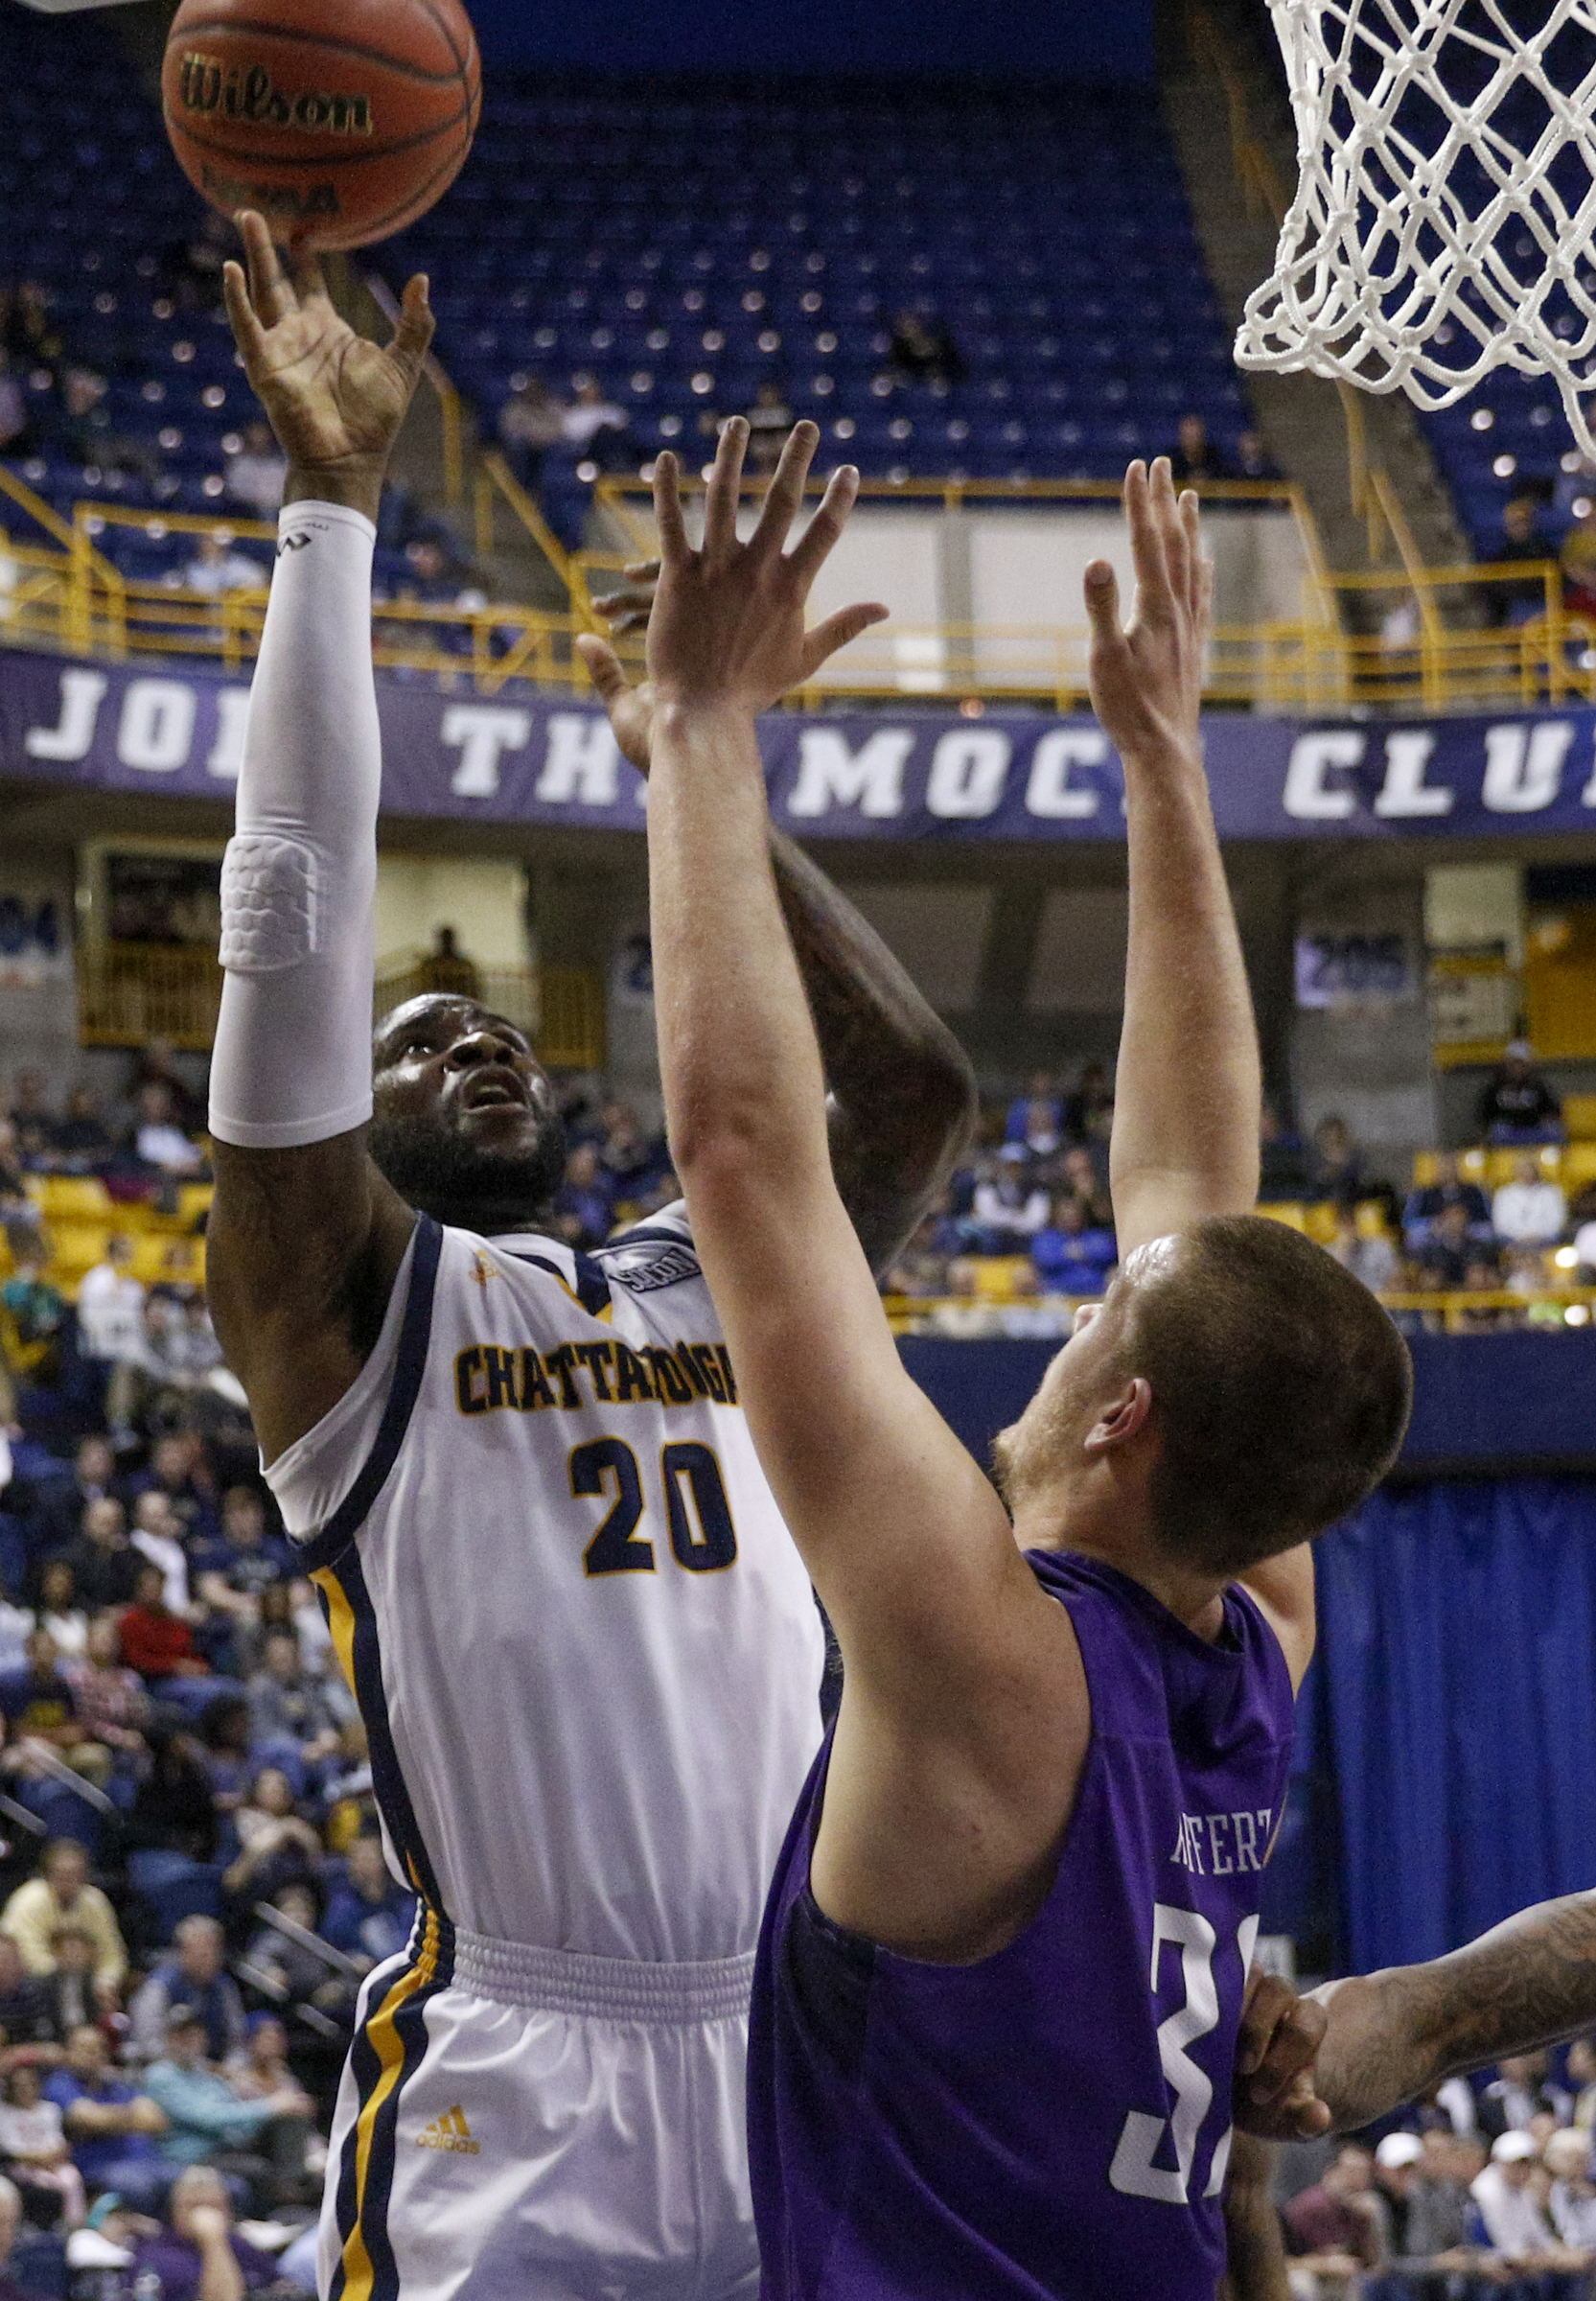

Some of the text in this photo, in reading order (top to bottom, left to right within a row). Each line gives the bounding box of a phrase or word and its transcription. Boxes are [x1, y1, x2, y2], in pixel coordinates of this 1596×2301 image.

[180, 51, 373, 136] Wilson
[24, 668, 1596, 819] JOI TH MOC CLU
[567, 1435, 738, 1578] 20
[1109, 1902, 1260, 2204] 3
[415, 2134, 480, 2155] adidas
